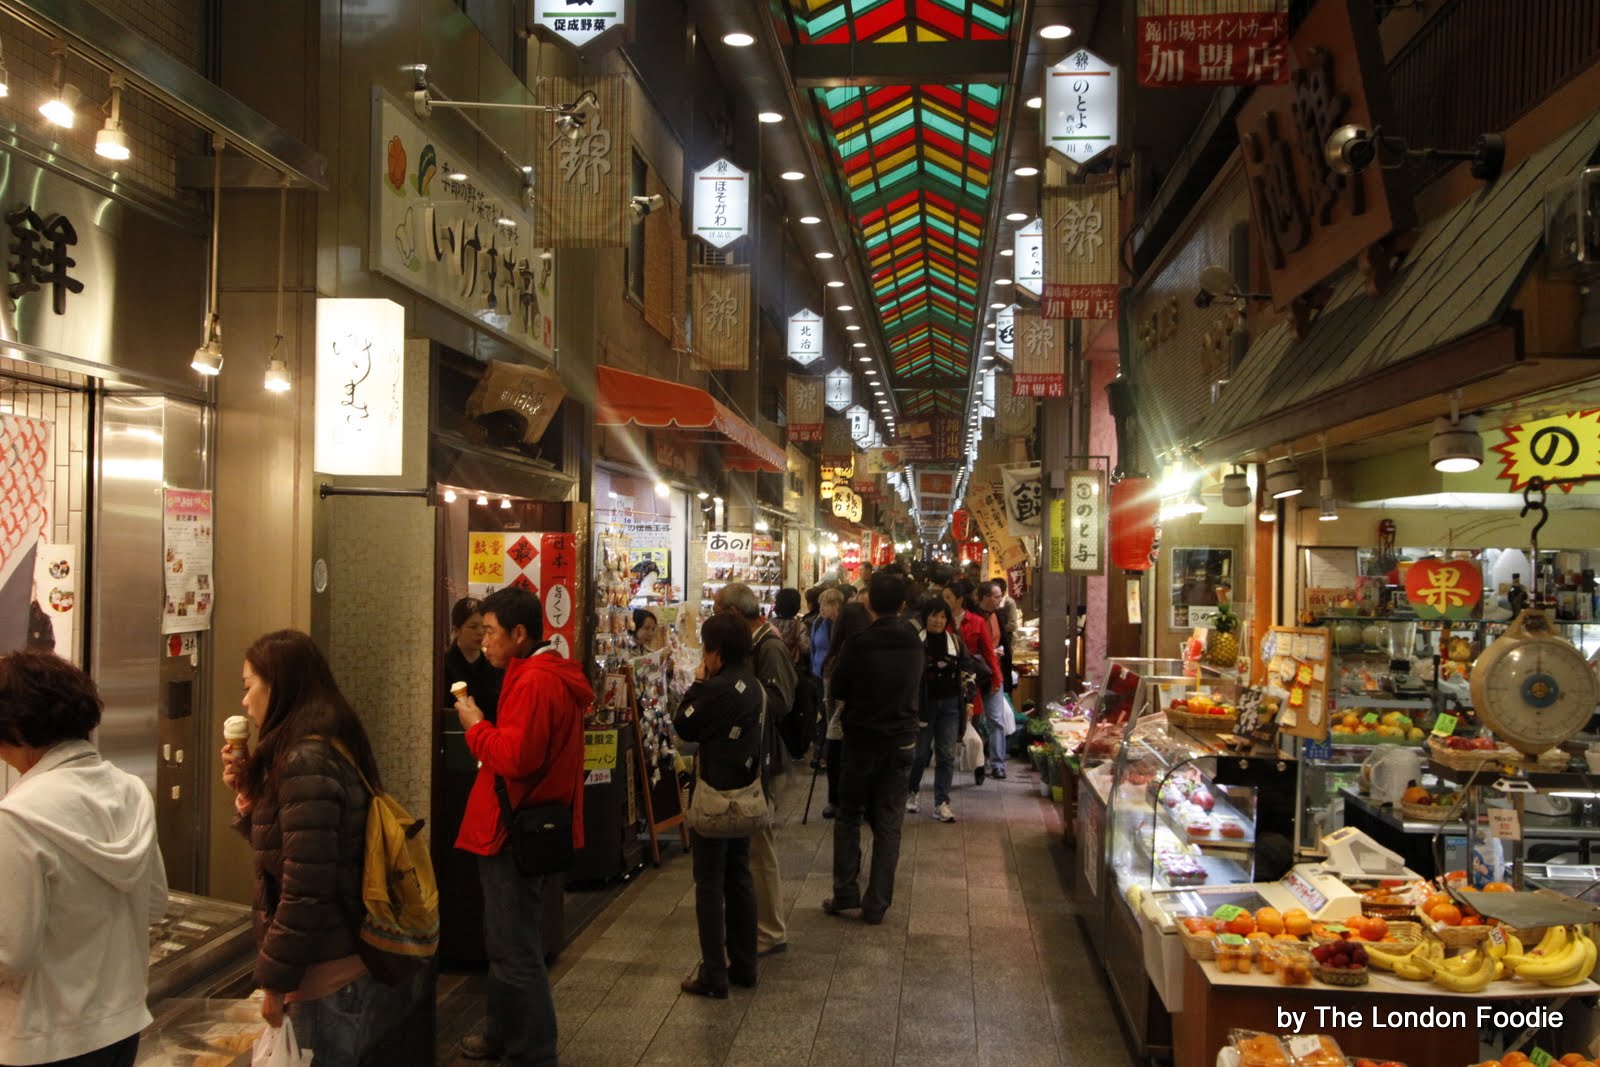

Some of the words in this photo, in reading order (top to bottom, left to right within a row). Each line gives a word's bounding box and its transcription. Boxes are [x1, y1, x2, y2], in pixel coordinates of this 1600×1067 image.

[553, 18, 606, 31] 促成野菜
[1145, 18, 1283, 43] 錦市場ポイントカード
[1145, 42, 1284, 82] 加盟店
[1073, 79, 1090, 129] のとよ
[714, 180, 727, 227] ほそかわ
[1053, 200, 1104, 264] 錦
[699, 288, 738, 339] 錦
[1045, 298, 1115, 320] 加盟店
[1015, 383, 1063, 397] 加盟店
[1529, 425, 1580, 467] の
[473, 541, 502, 556] 数量
[511, 542, 532, 563] 最
[710, 533, 751, 550] あの!
[473, 562, 503, 577] 限定
[551, 537, 567, 580] 日本一
[1417, 568, 1471, 615] 果
